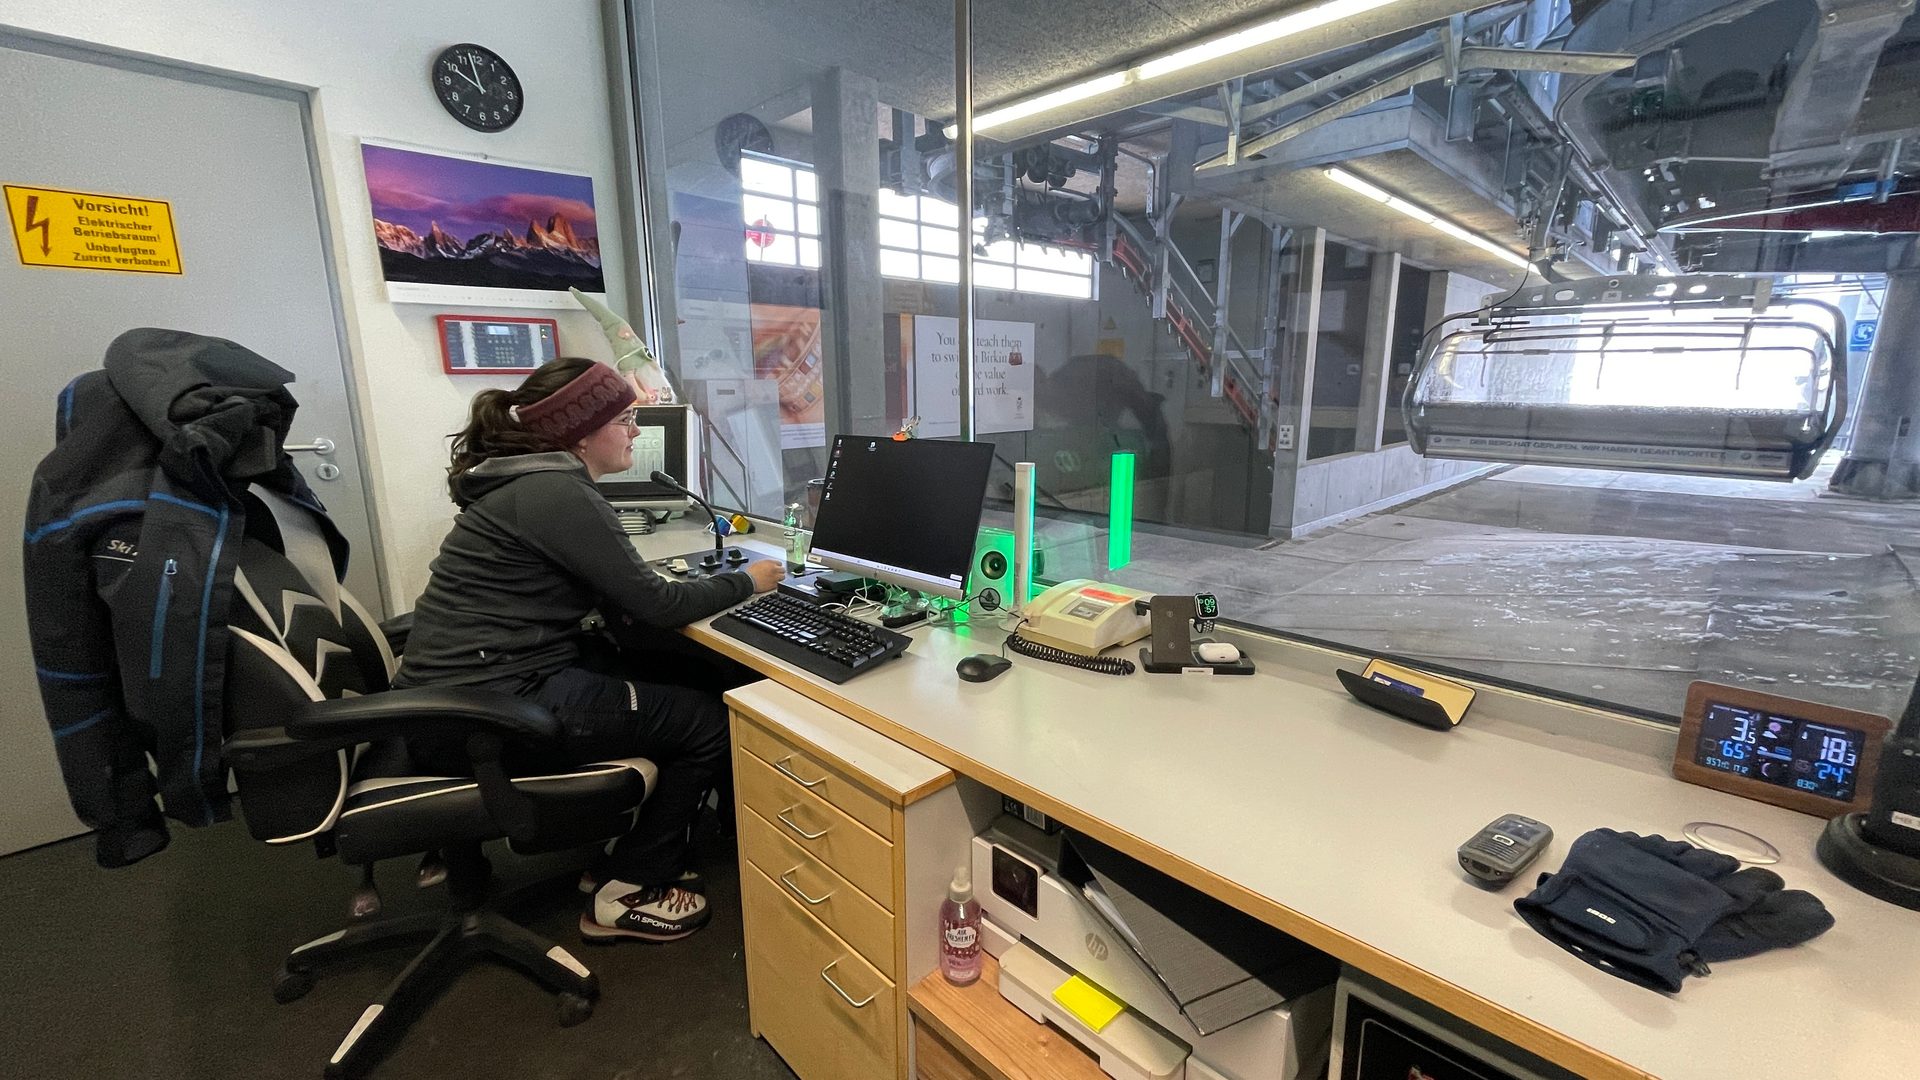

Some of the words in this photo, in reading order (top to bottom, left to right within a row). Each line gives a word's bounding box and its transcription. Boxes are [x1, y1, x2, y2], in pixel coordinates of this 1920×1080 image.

[458, 55, 468, 65] 11
[472, 55, 483, 66] 12
[447, 63, 458, 72] 10
[490, 63, 495, 72] 1
[444, 76, 452, 85] 9
[500, 76, 507, 85] 2
[452, 92, 459, 101] 8
[507, 91, 514, 100] 3
[463, 104, 471, 113] 7
[503, 104, 510, 112] 4
[479, 112, 487, 121] 6
[493, 111, 500, 120] 5
[72, 198, 149, 216] Vorsicht!
[77, 215, 153, 231] Elektrischer
[73, 227, 161, 243] Betriebsraum!
[85, 242, 156, 256] Unbefugten
[73, 252, 112, 264] Zutritt
[114, 255, 171, 267] verboten!
[936, 331, 955, 346] You
[976, 334, 999, 348] teach
[1001, 334, 1022, 348] them
[931, 352, 941, 362] to
[980, 350, 1008, 364] Birkin
[984, 366, 1006, 379] value
[985, 382, 1009, 396] work.
[107, 539, 135, 554] Ski
[1204, 598, 1215, 606] 09
[629, 912, 641, 922] LA
[641, 916, 682, 930] SPORTIVA
[1087, 933, 1108, 960] hp
